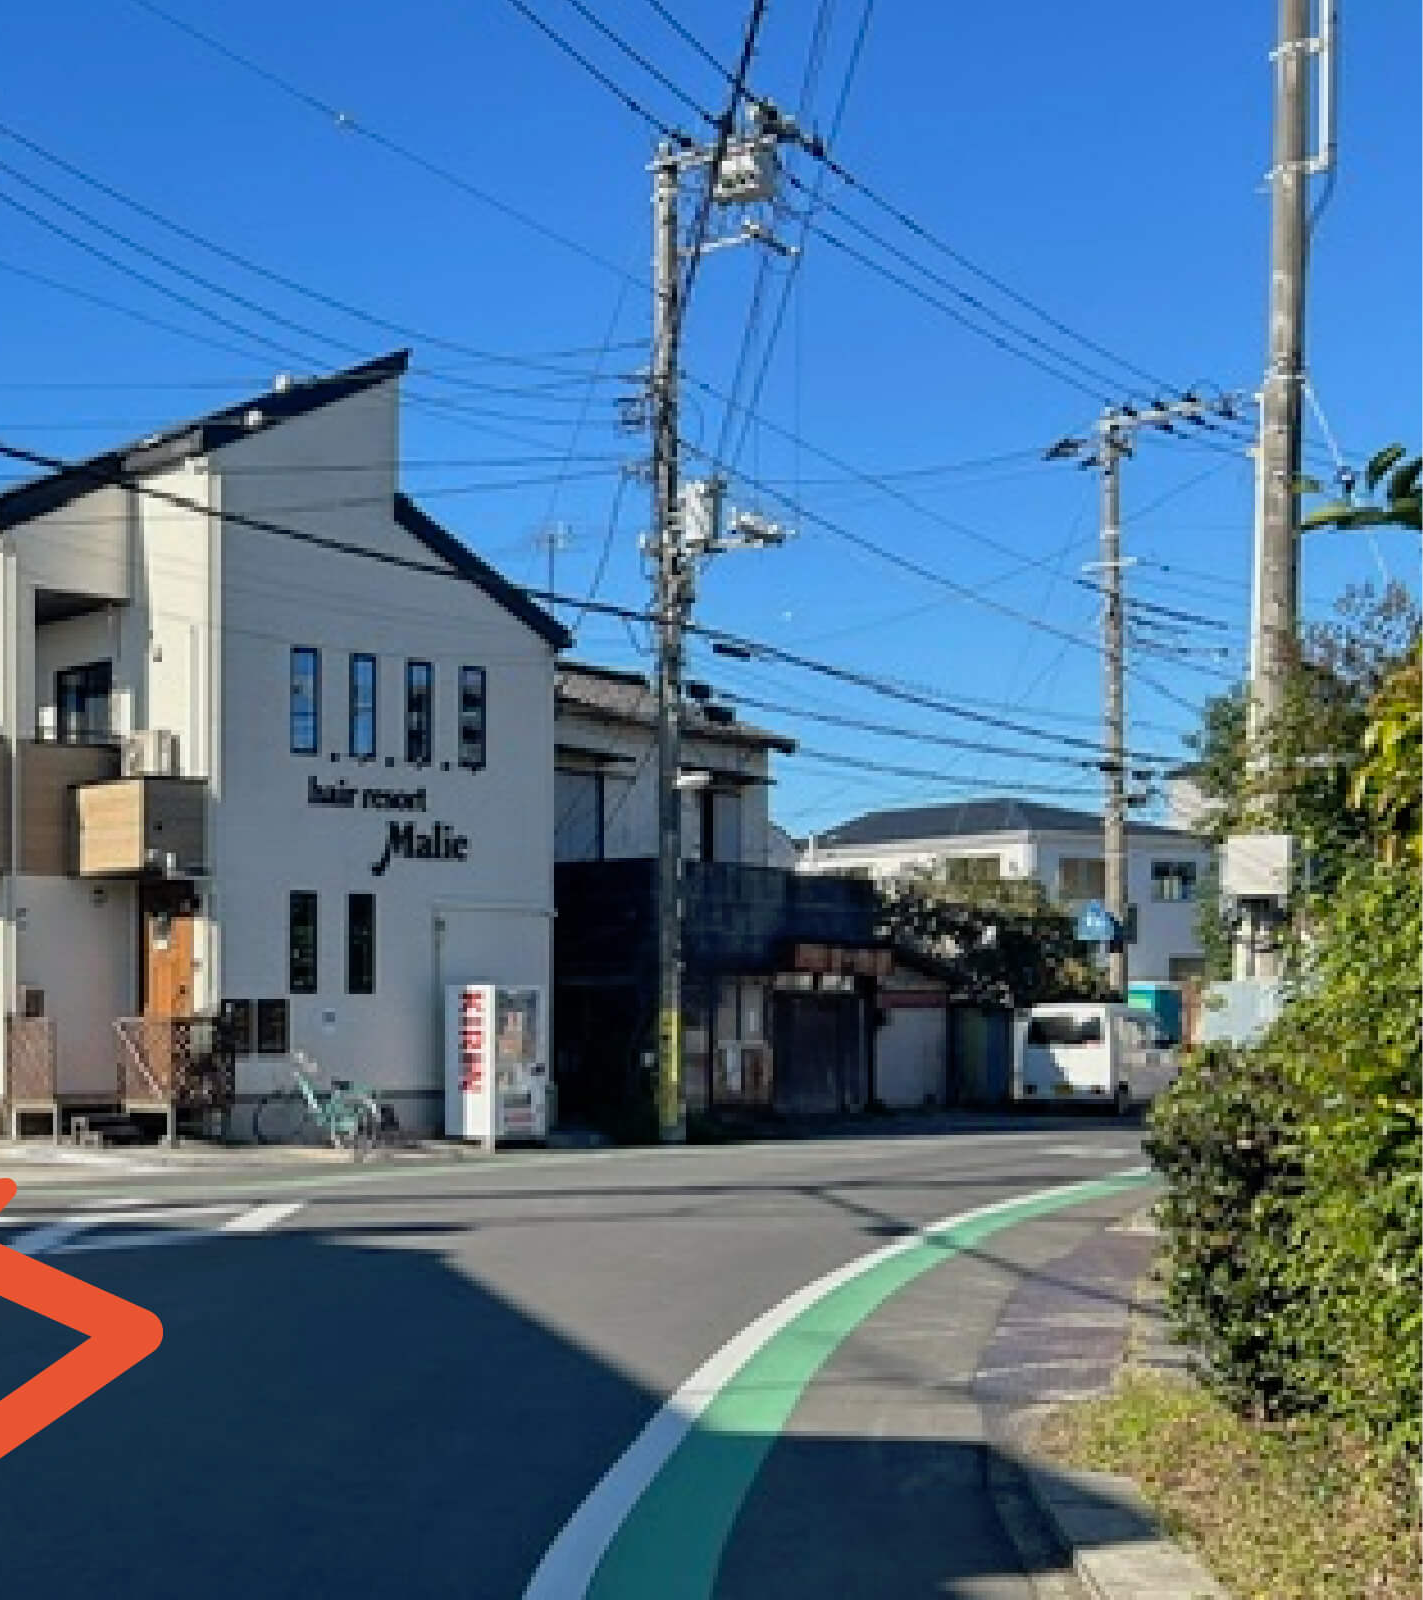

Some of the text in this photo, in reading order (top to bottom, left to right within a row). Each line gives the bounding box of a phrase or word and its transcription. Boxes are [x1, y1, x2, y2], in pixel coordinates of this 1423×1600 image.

[308, 776, 427, 812] hair resort
[371, 820, 471, 876] Malie
[457, 988, 483, 1094] KIRIN
